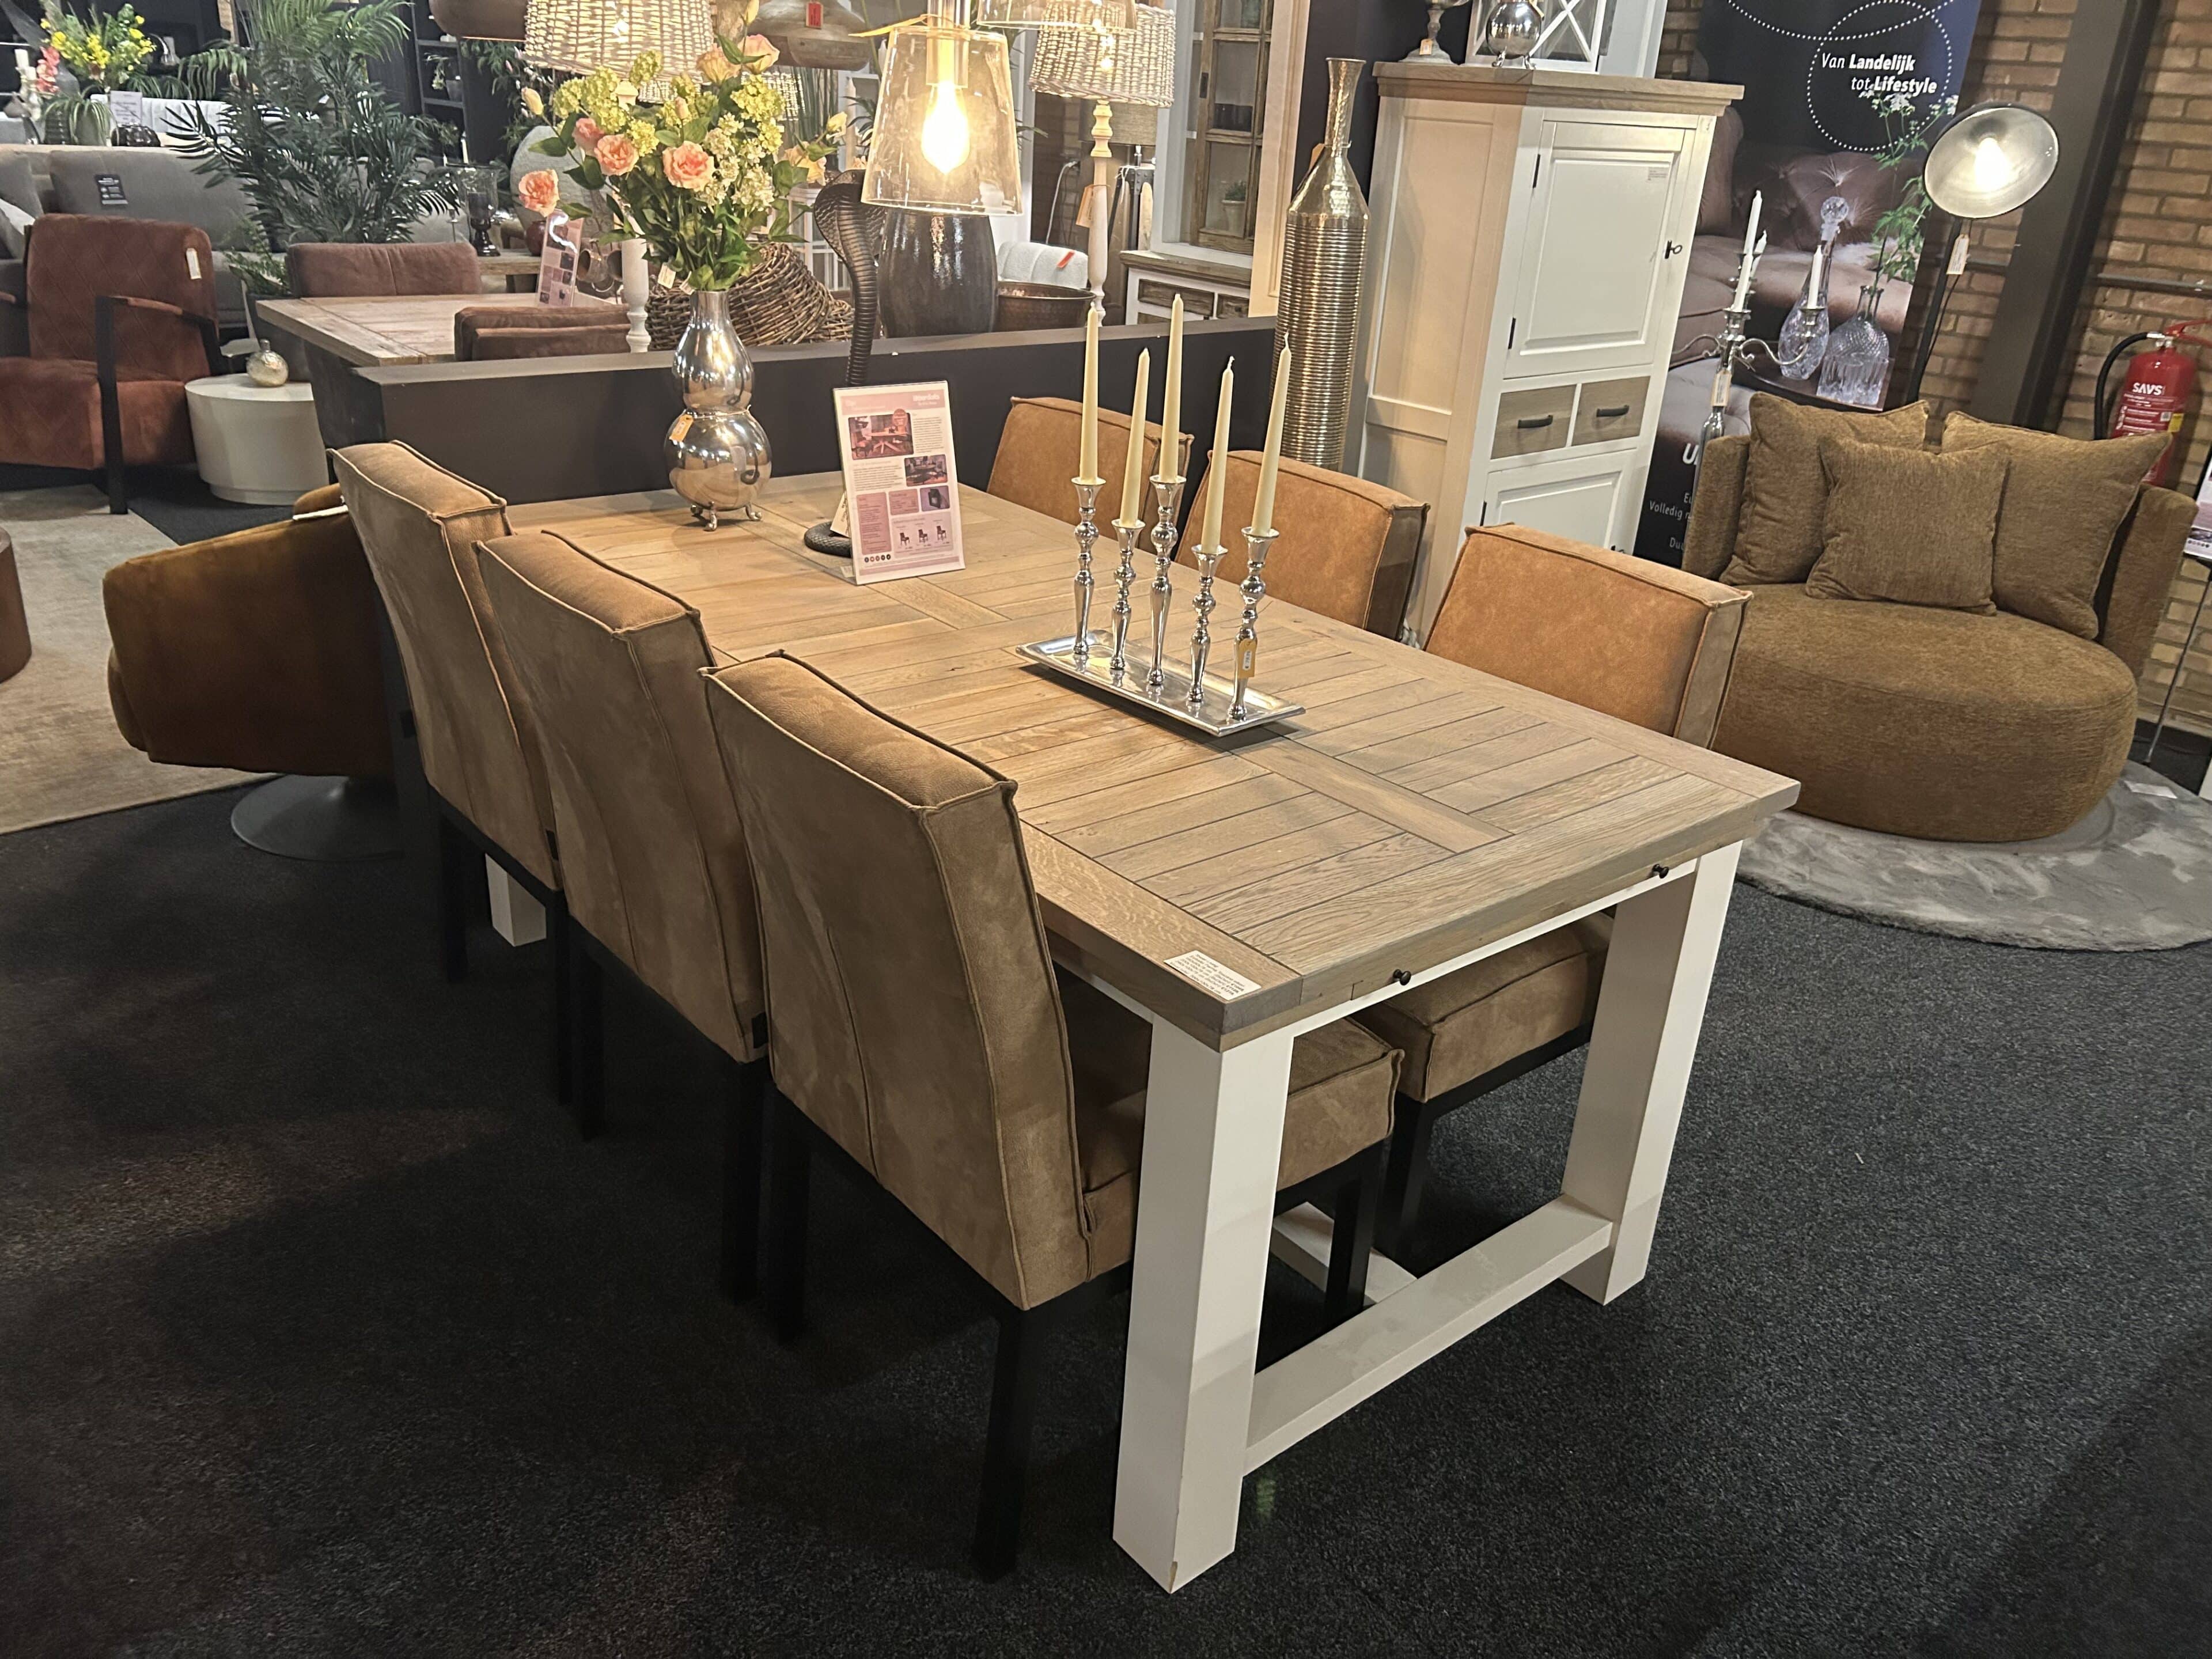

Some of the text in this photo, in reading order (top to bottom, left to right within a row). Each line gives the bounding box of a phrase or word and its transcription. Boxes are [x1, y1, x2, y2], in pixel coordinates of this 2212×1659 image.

[1822, 52, 1916, 75] Van Landelijk
[1851, 75, 1938, 97] tot Lifestyle
[2132, 382, 2162, 396] SAVS
[1683, 443, 1698, 465] U
[1649, 500, 1683, 521] Volledig
